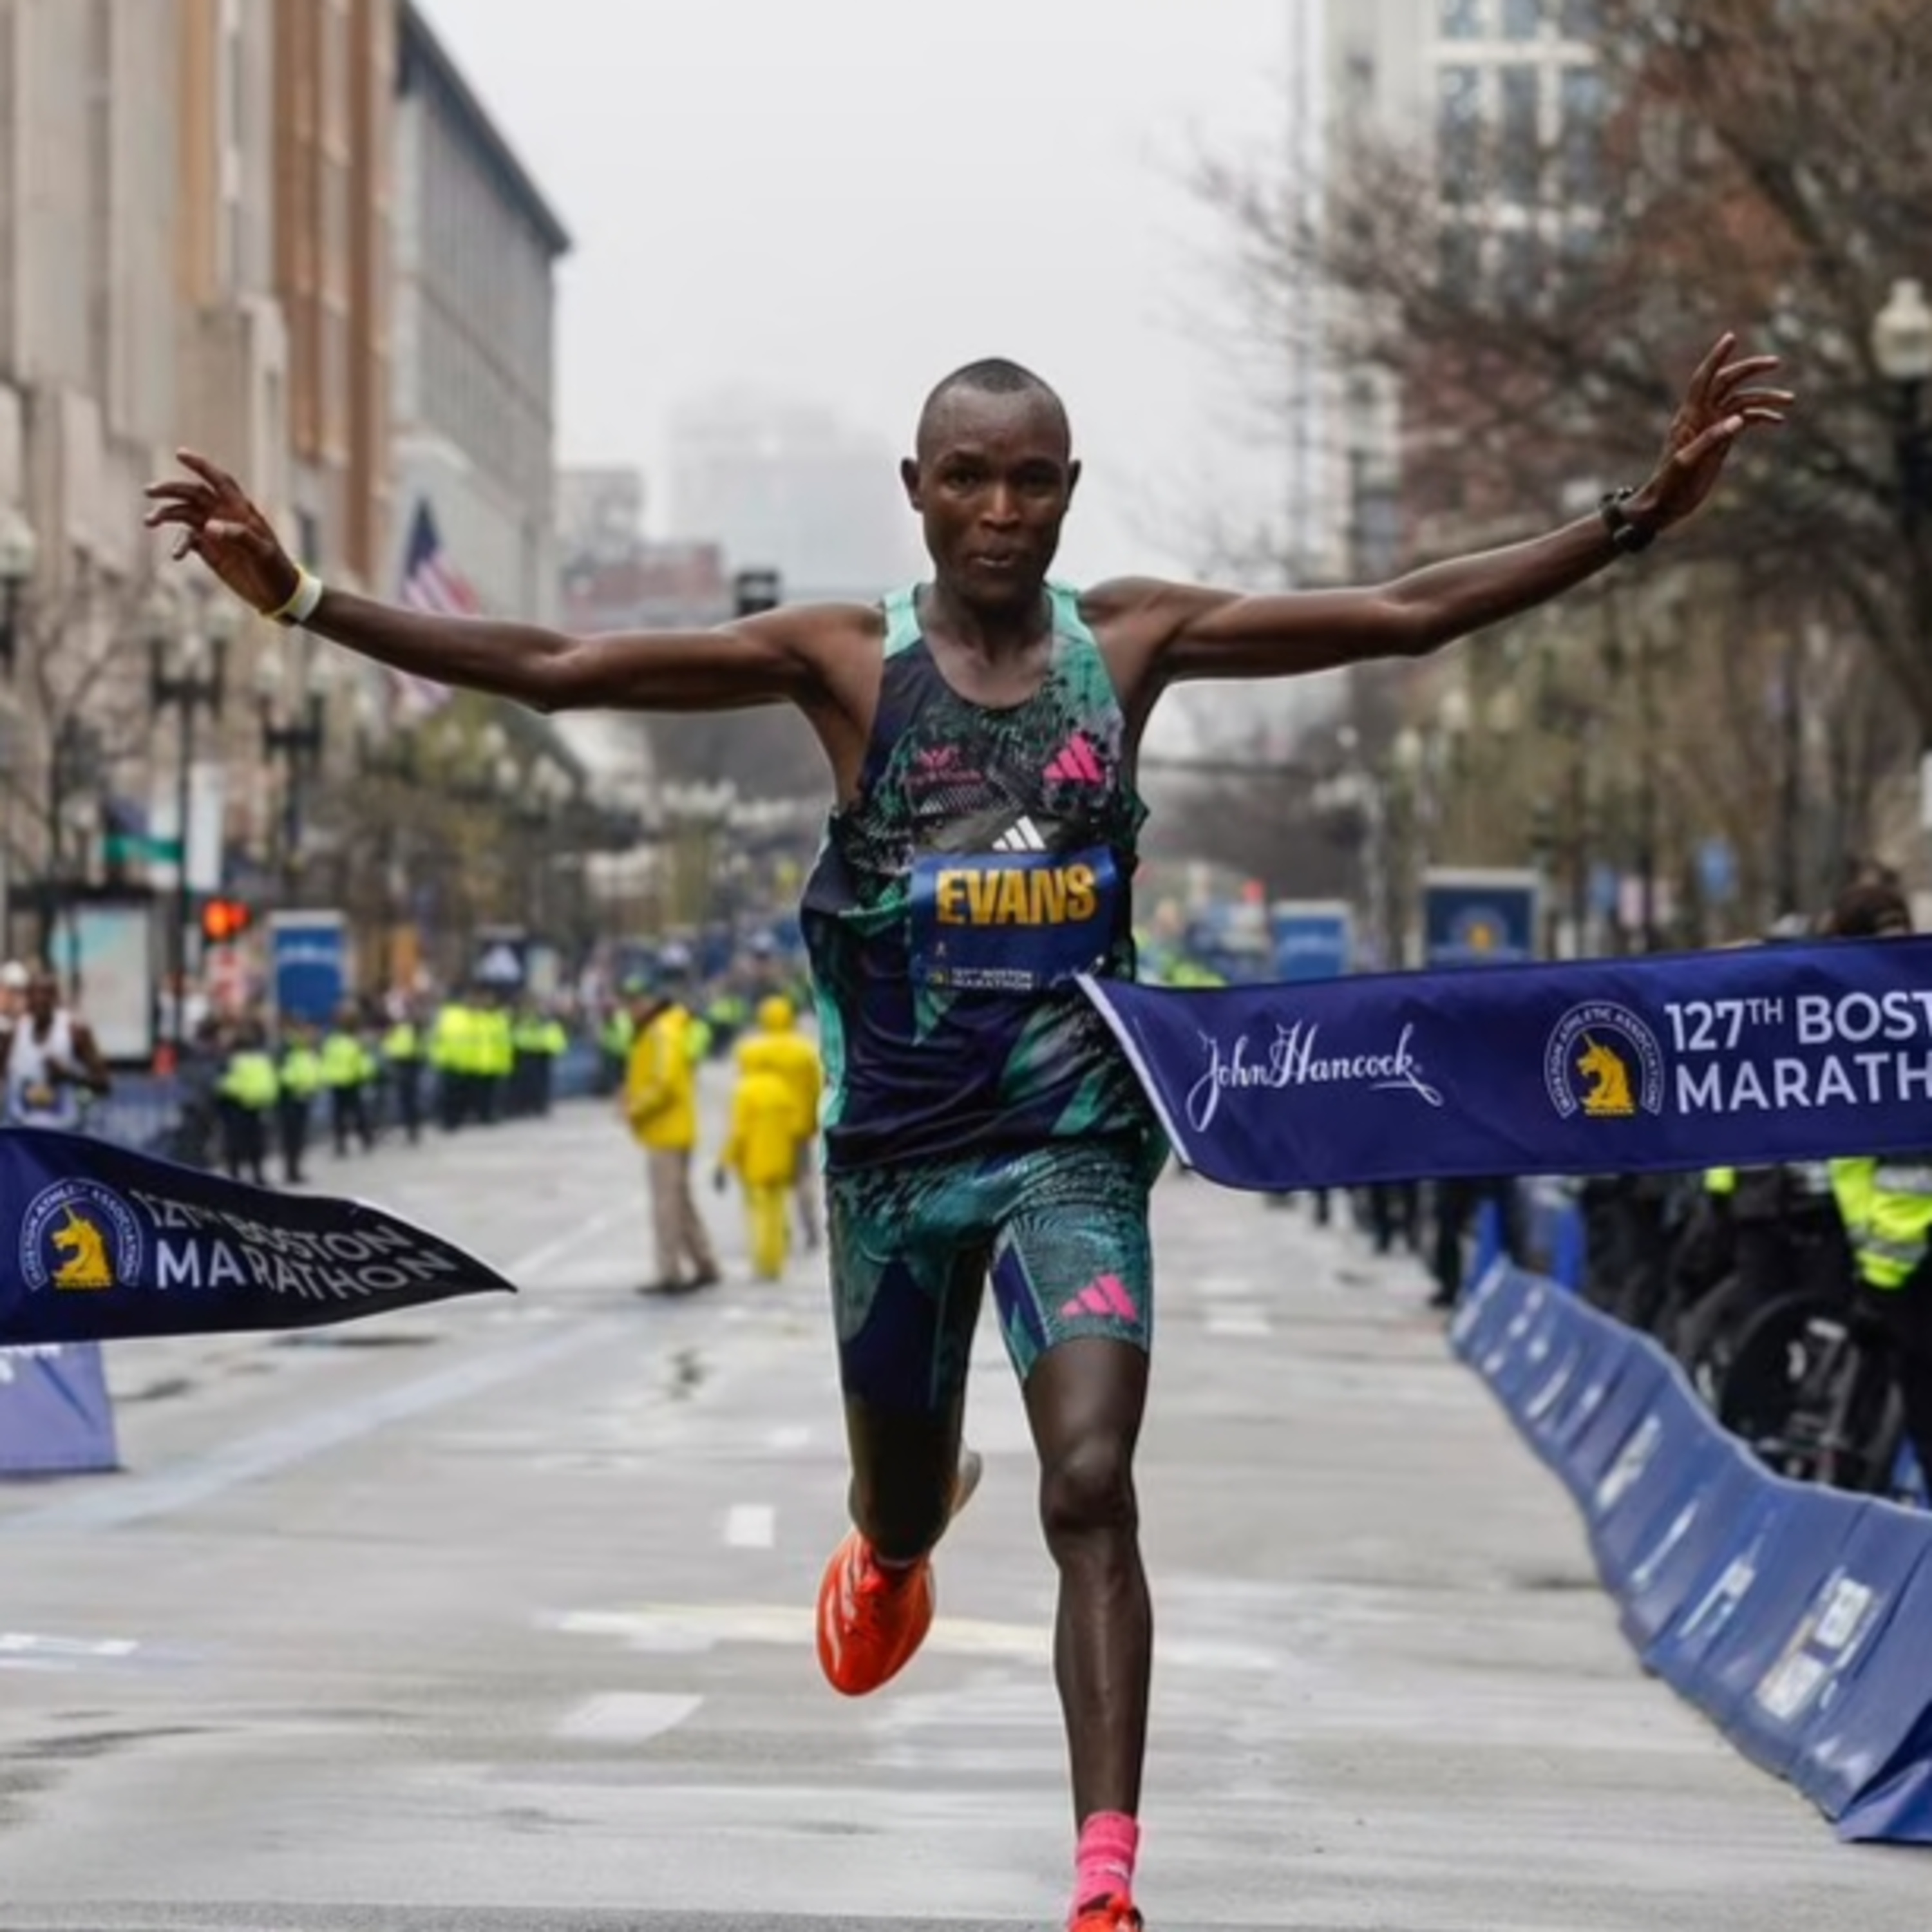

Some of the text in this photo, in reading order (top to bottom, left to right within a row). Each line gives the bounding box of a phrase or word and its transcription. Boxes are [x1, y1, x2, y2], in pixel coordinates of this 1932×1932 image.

[935, 863, 1096, 925] EVANS
[1665, 997, 1784, 1052] 127TH
[1676, 1050, 1932, 1115] MARATH
[221, 1212, 415, 1262] BOSTON
[156, 1238, 459, 1300] MARATHON
